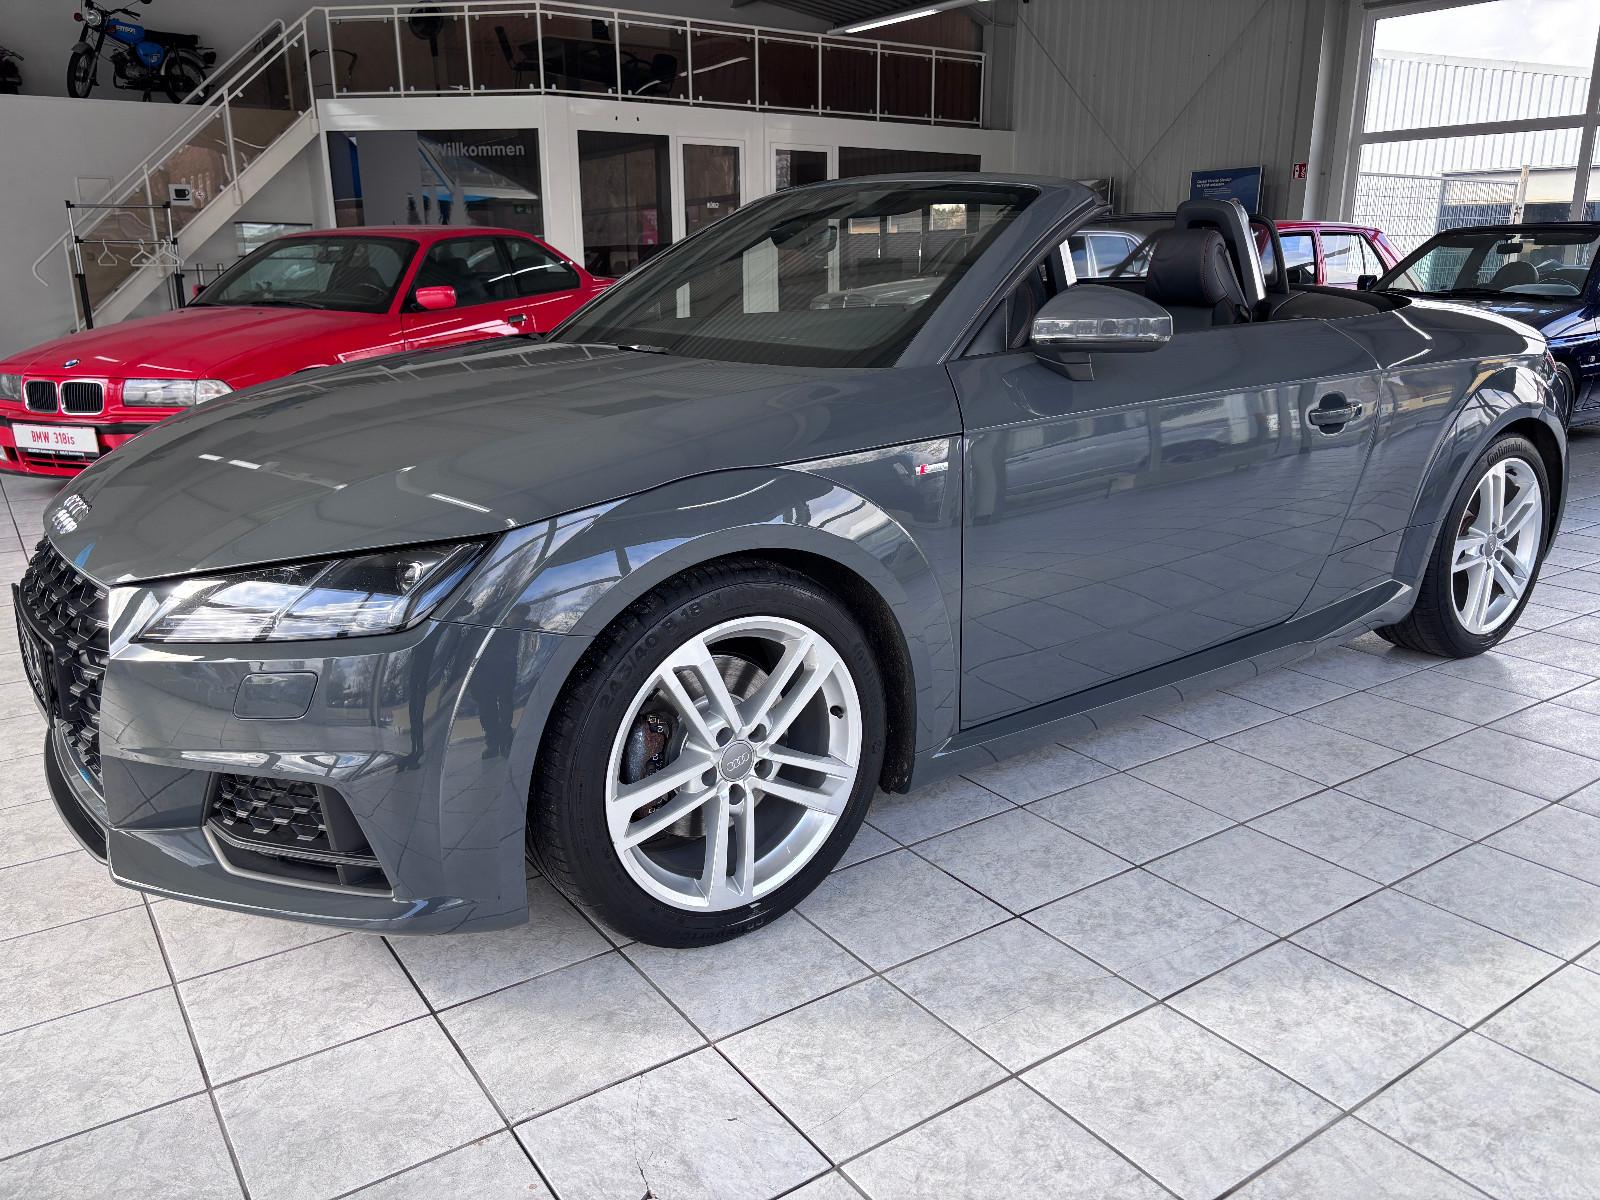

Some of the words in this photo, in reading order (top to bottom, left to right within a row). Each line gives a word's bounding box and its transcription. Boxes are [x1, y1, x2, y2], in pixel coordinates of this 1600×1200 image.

[435, 142, 525, 157] Willkommen
[31, 430, 50, 444] BMW
[53, 432, 76, 445] 318is
